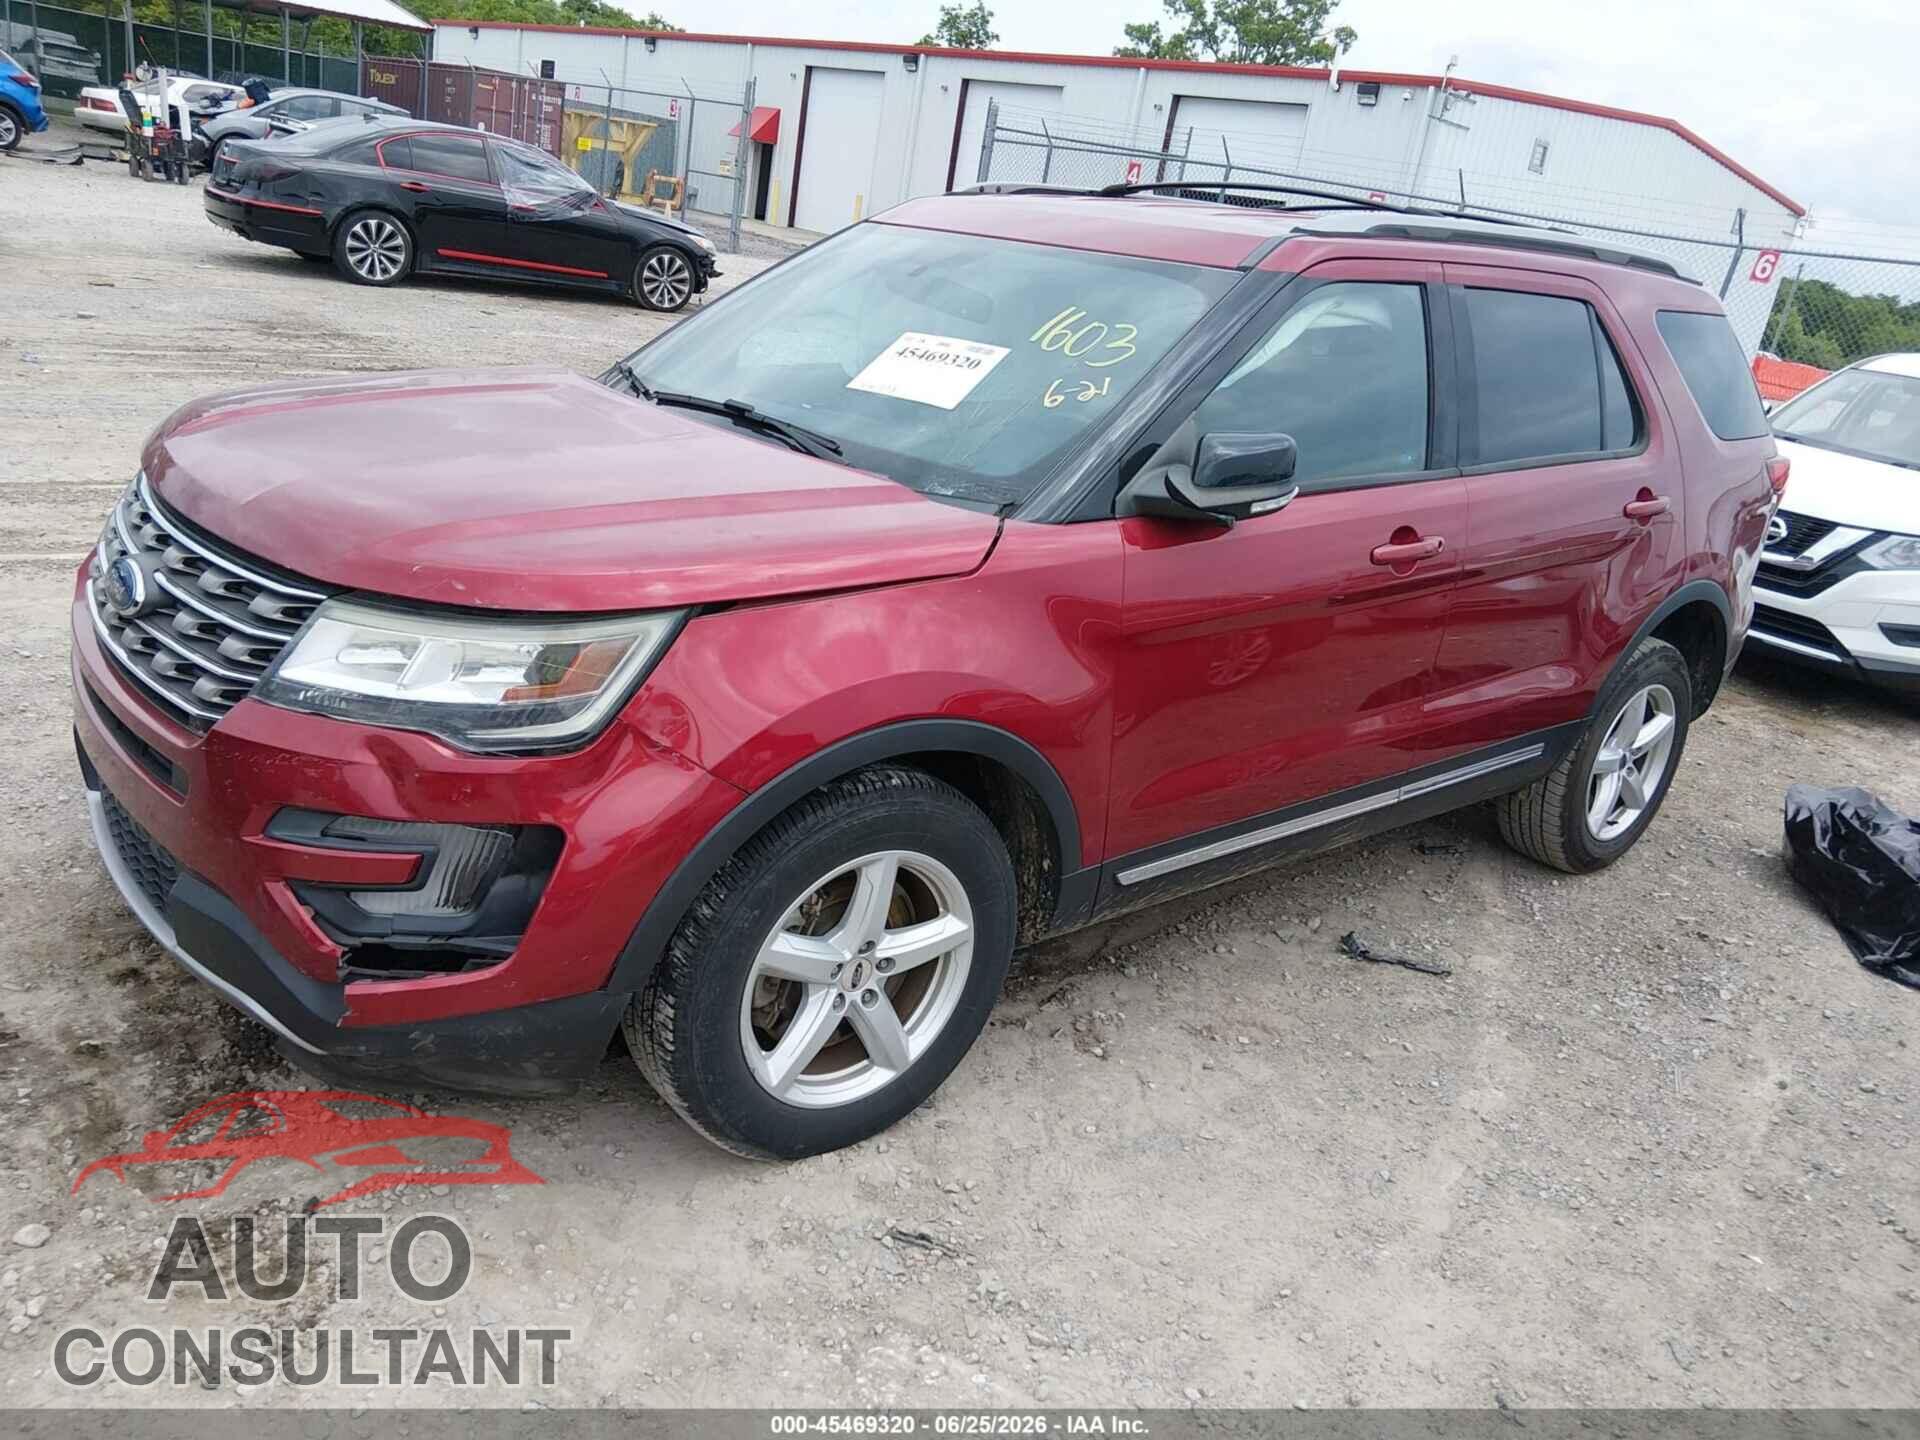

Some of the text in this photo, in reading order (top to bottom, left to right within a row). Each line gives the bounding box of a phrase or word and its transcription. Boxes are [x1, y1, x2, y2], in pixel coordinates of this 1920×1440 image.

[1127, 164, 1140, 183] 4
[1754, 253, 1776, 280] 6
[1029, 305, 1138, 367] 1603
[896, 345, 982, 370] 45469320
